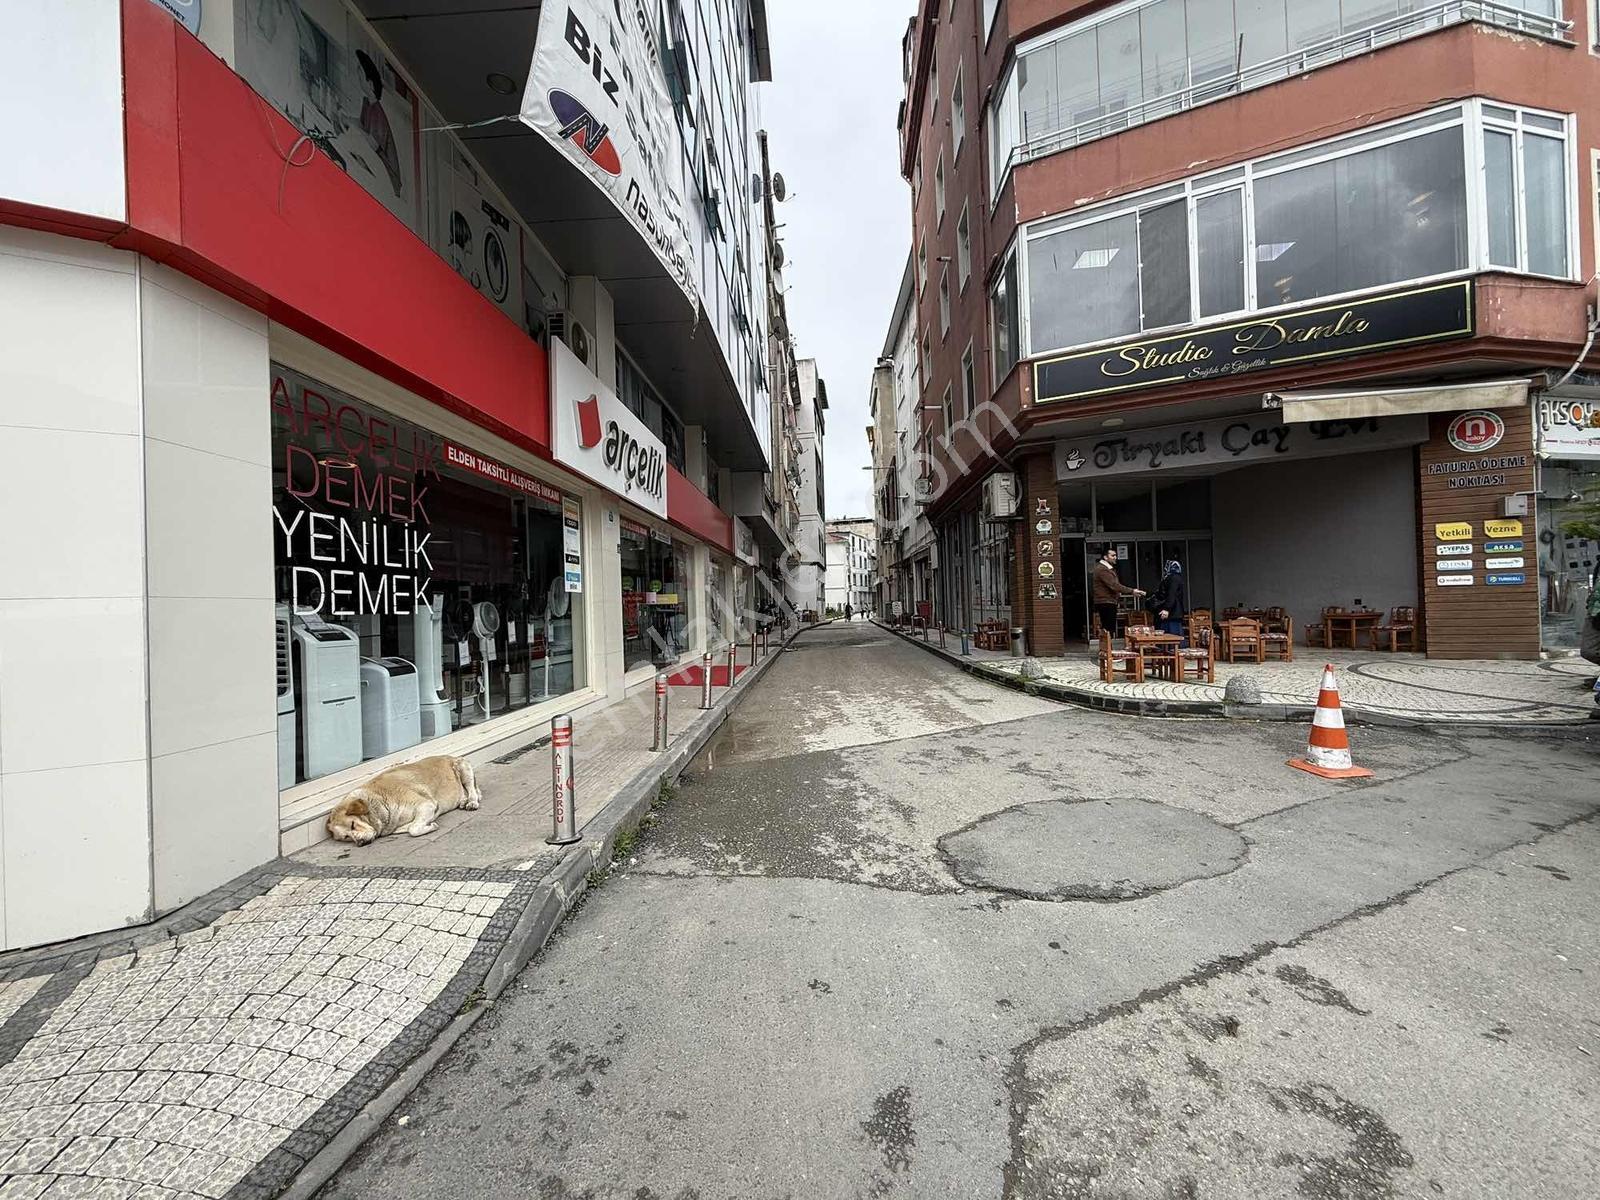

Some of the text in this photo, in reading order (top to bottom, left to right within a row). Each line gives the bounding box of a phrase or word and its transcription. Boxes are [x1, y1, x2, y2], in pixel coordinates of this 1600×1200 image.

[564, 6, 620, 109] Biz
[1100, 310, 1371, 377] Studio Damla
[1540, 401, 1593, 427] AKSOY
[602, 420, 664, 499] arçelik
[1092, 431, 1206, 469] Tiryaki
[1221, 422, 1291, 456] Çay
[1428, 455, 1526, 475] FATURA ÖDEME
[287, 444, 431, 525] DEMEK
[448, 446, 476, 469] ELDEN
[477, 458, 510, 482] TAKSİTLİ
[510, 472, 541, 497] ALIŞVERİŞ
[1448, 473, 1506, 488] NOKTASI
[272, 505, 434, 571] YENİLİK
[1440, 525, 1517, 537] Yetkili Vezne
[292, 566, 434, 615] DEMEK
